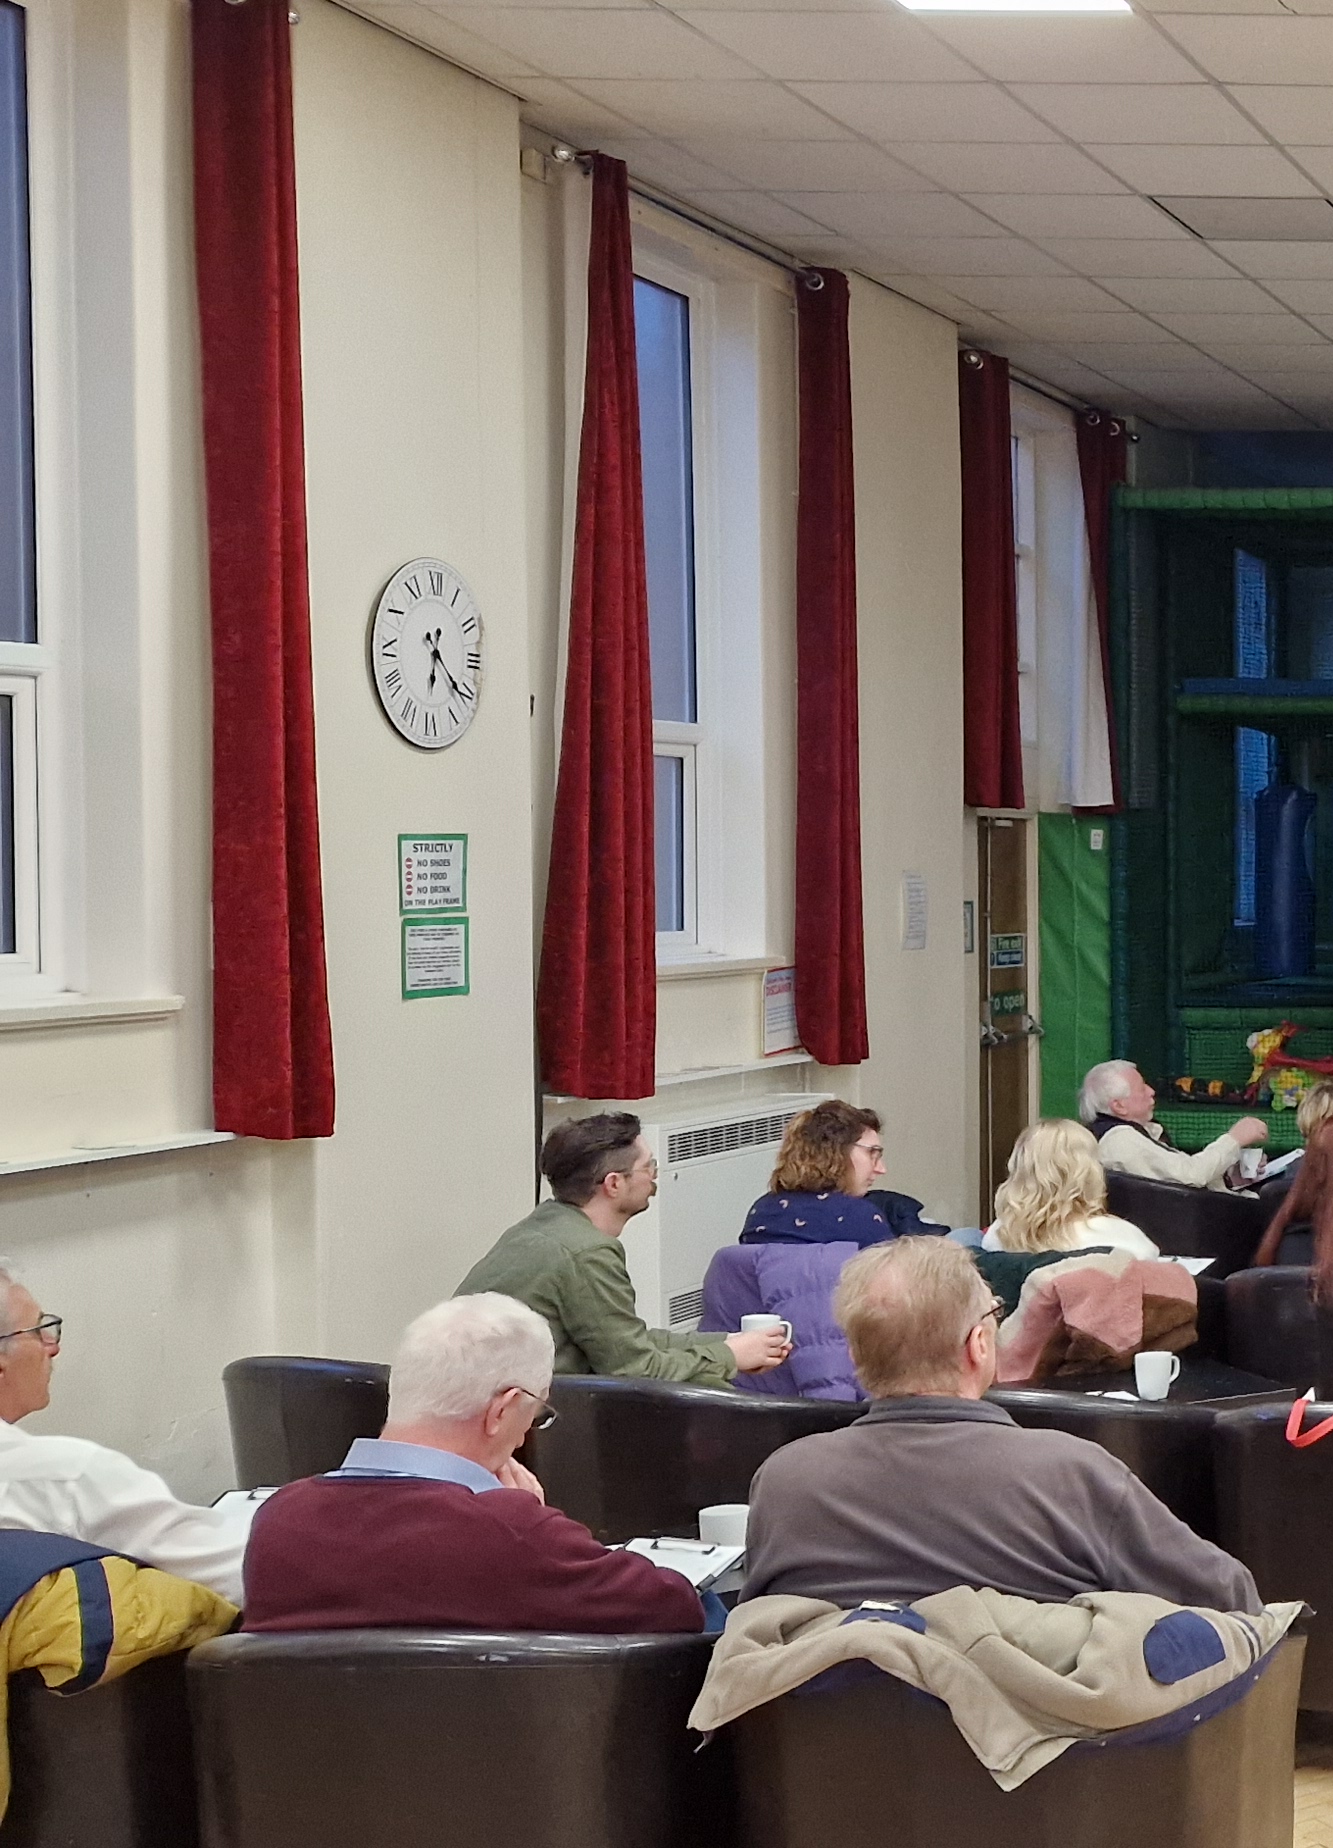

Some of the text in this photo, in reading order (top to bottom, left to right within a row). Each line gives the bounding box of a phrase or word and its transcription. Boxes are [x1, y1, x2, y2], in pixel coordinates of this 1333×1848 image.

[413, 843, 453, 853] STRICTLY
[417, 859, 450, 867] NO SHOES
[430, 872, 447, 880] FOOD
[417, 886, 451, 894] NO DRINK
[1003, 994, 1025, 1012] open
